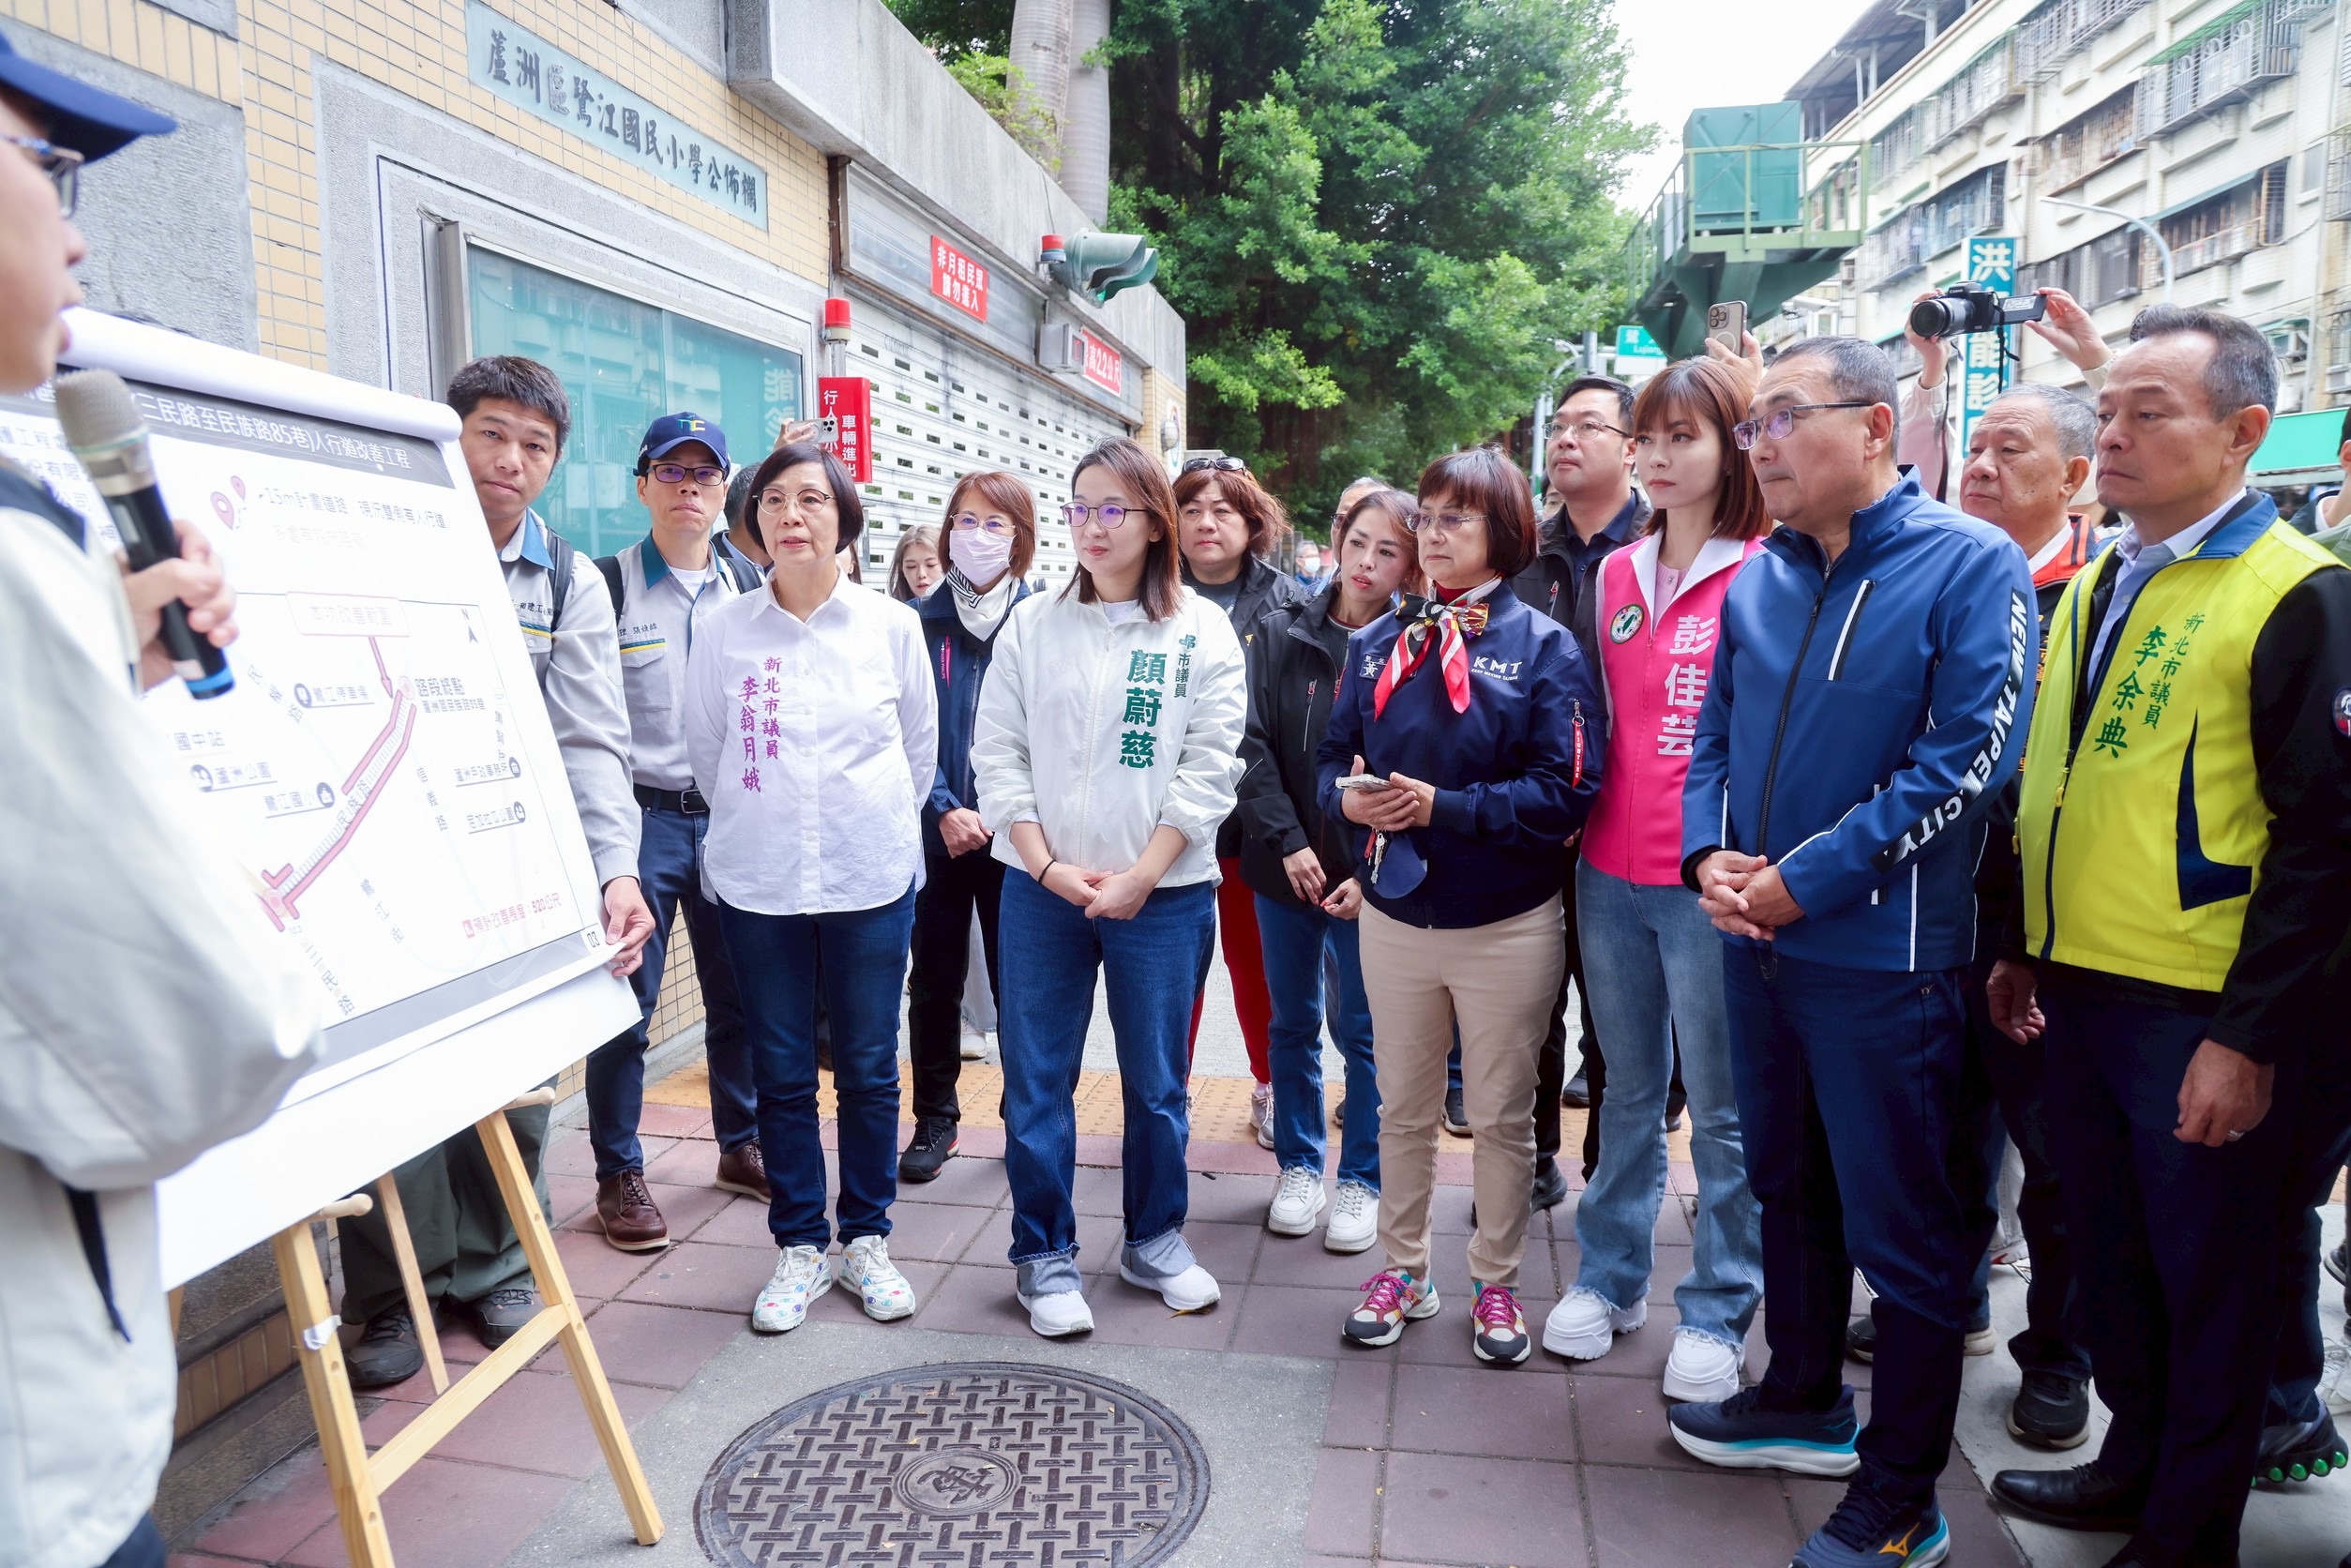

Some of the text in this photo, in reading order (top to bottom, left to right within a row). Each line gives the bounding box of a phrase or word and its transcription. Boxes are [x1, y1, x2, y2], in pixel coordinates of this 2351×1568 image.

[487, 28, 758, 214] 蘆洲區鷺江國民小學公佈欄
[937, 244, 985, 292] 非月租民眾
[942, 272, 980, 312] 請勿進入
[414, 677, 465, 698] 路段終點
[761, 656, 783, 761] 新北市議員
[1119, 649, 1168, 770] 顏蔚慈
[1473, 656, 1523, 675] KMT
[1657, 614, 1717, 758] 彭佳芸
[1901, 592, 2027, 856] NEW TAIPEI CITY
[2094, 625, 2166, 759] 李余典
[2142, 611, 2206, 730] 新北市議員
[738, 675, 761, 793] 李翁月娥
[586, 930, 601, 948] 03
